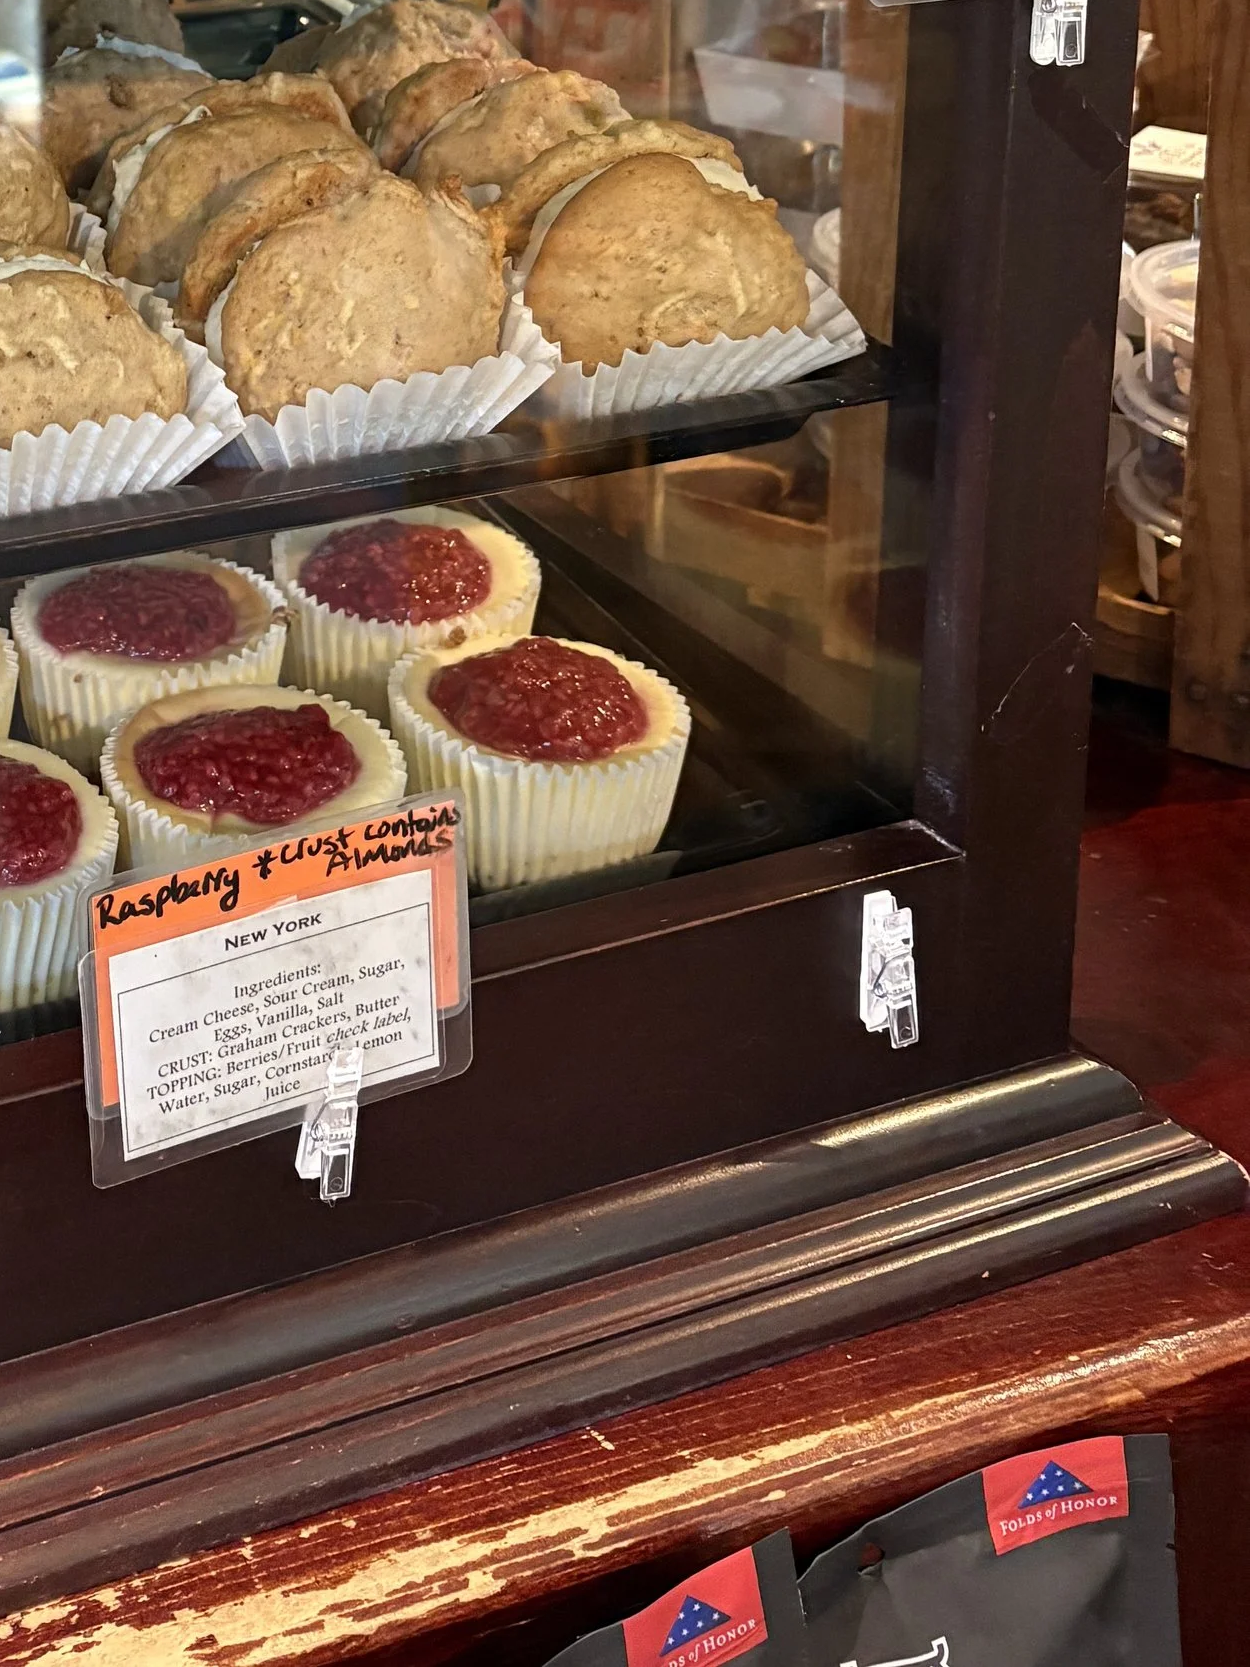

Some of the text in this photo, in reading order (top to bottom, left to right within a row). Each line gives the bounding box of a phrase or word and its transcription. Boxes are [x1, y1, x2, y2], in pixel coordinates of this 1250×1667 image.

[96, 869, 240, 929] Raspberry
[364, 805, 461, 841] contains
[224, 913, 323, 952] NEW YORK
[149, 958, 406, 1043] Cream Cheese, Sour Cream, Sugar,
[234, 963, 322, 999] Ingredients:
[158, 994, 400, 1078] CRUST: Graham Crackers, Butter
[214, 991, 344, 1043] Eggs, Vanilla, Salt
[146, 1007, 412, 1100] TOPPING: Berries/Fruit check label,
[159, 1090, 210, 1115] Water,
[214, 1075, 262, 1098] Sugar,
[264, 1080, 301, 1101] Juice
[1000, 1496, 1118, 1536] FOLDS of HONOR
[688, 1644, 701, 1662] of
[702, 1619, 756, 1653] HONOR
